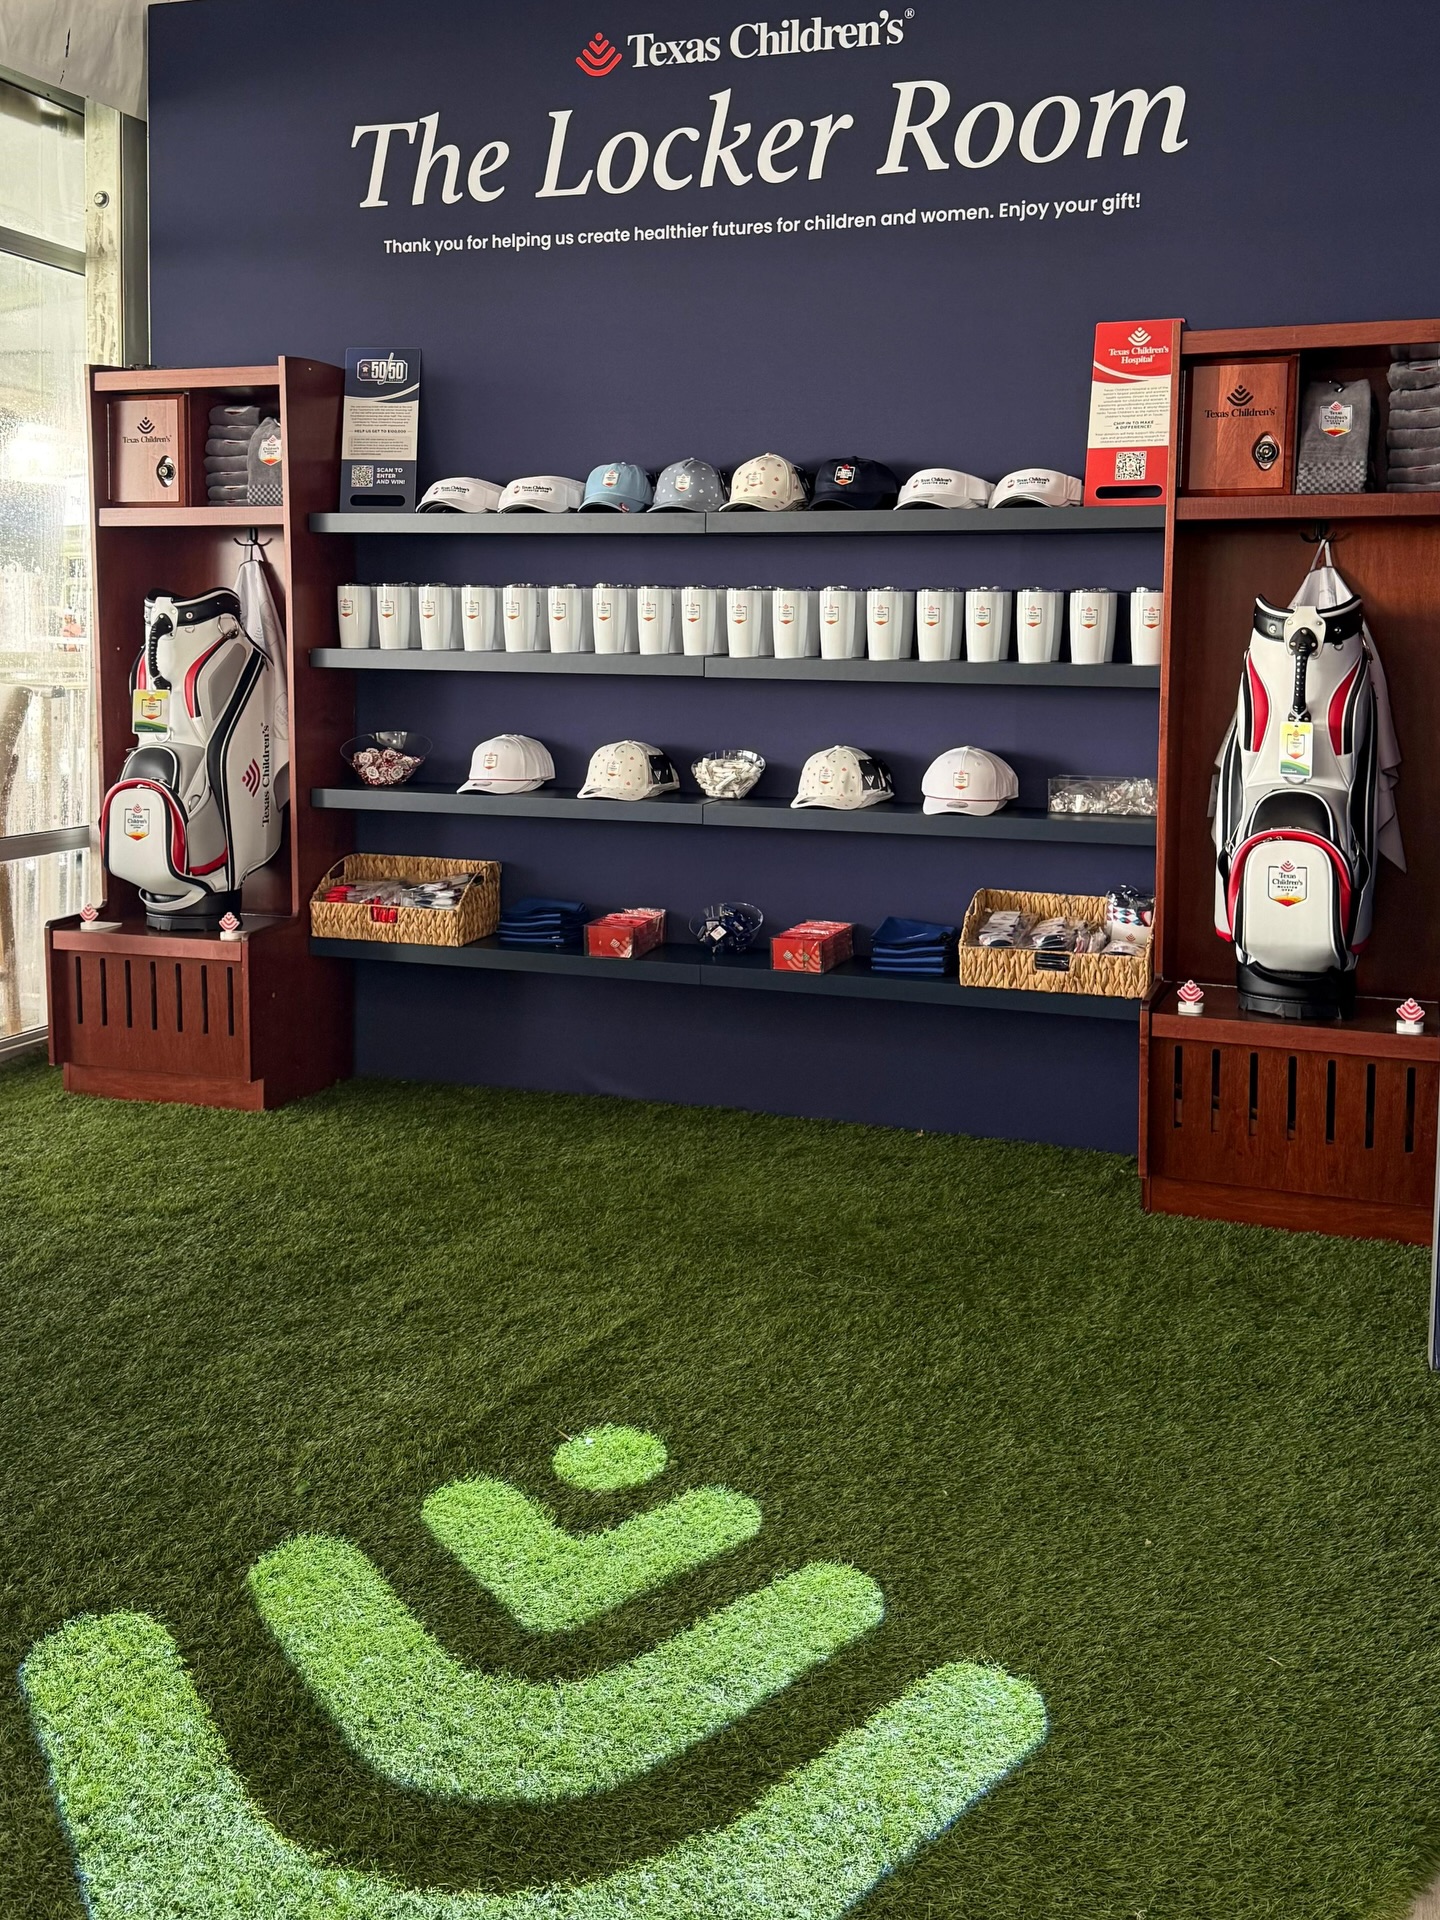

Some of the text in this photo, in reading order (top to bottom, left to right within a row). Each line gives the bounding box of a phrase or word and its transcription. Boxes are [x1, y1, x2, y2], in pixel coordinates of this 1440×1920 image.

[627, 34, 721, 68] Texas
[350, 81, 1189, 208] The Locker Room
[384, 192, 1141, 256] Thank you for helping us create healthier futures for children and women. Enjoy your gift!
[1108, 346, 1169, 357] Texas Children's
[1205, 407, 1276, 418] Texas Children's
[122, 436, 140, 444] Texas
[262, 725, 270, 828] Texas Children's
